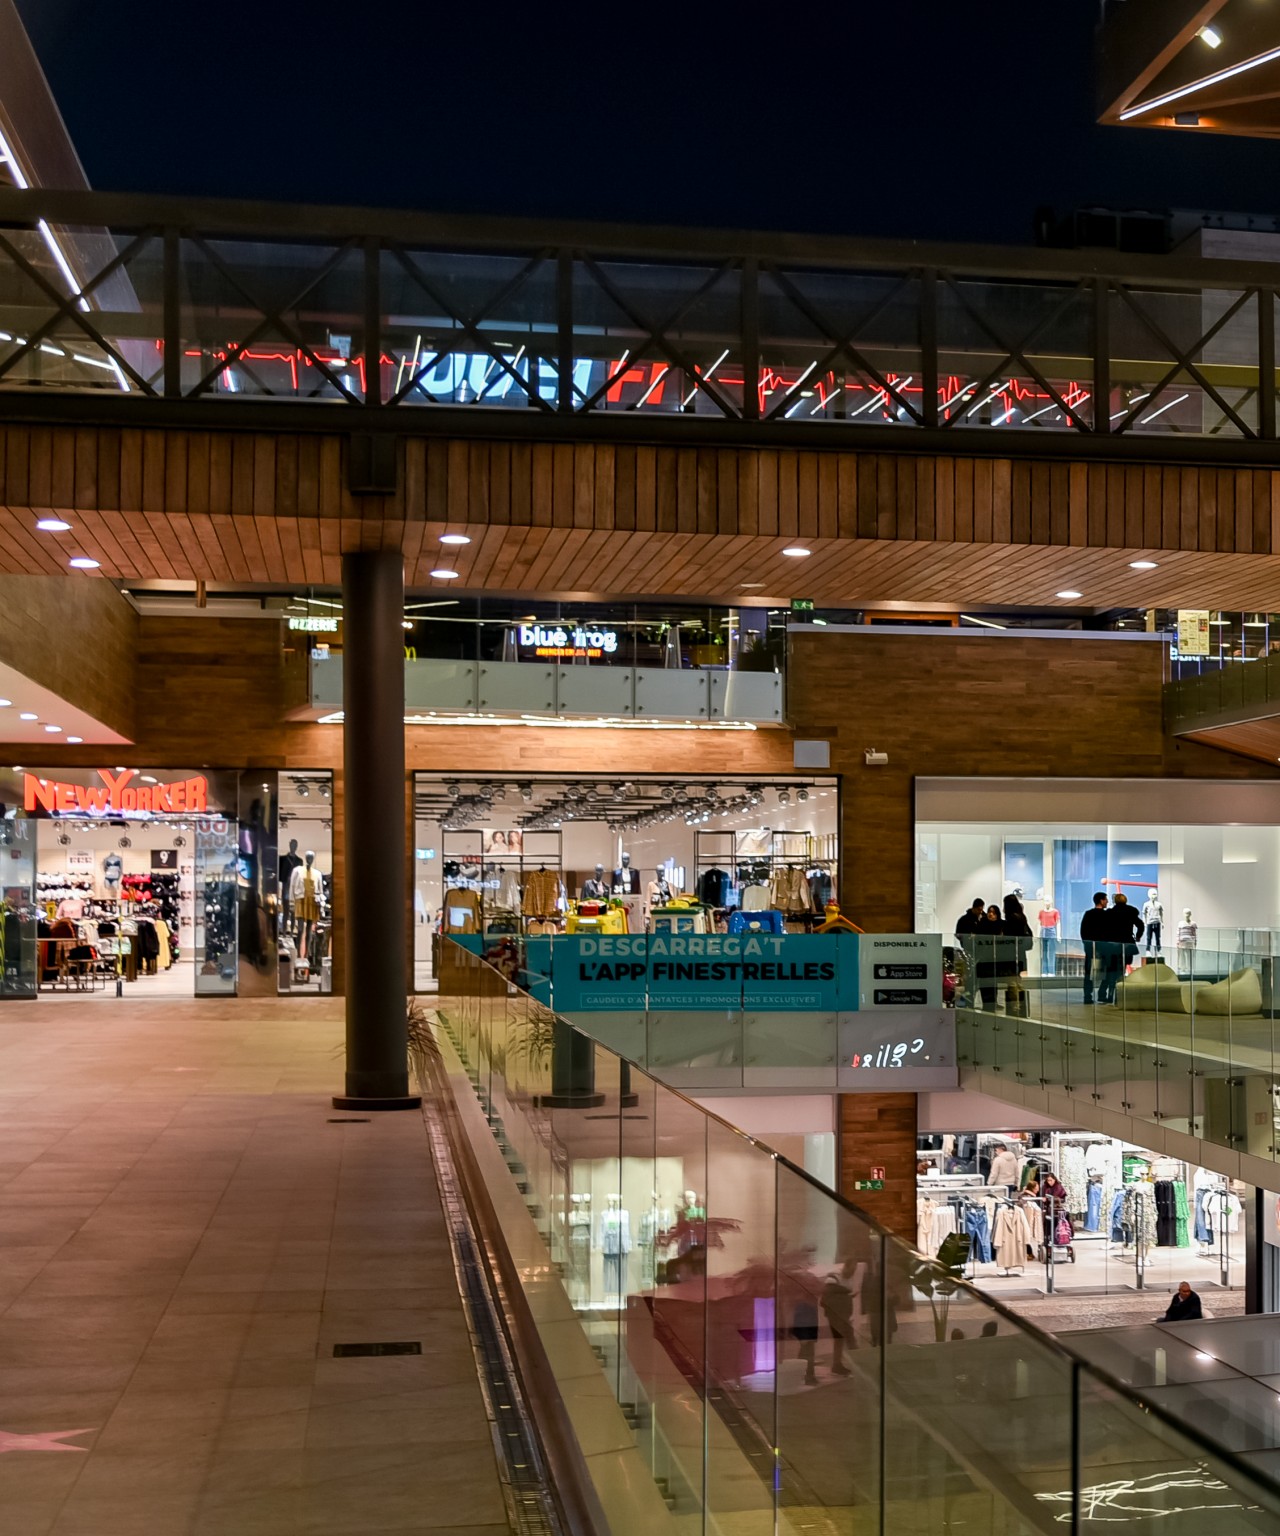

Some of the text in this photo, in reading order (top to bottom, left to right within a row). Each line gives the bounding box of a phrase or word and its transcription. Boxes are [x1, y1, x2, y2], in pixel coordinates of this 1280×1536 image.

[519, 625, 568, 647] blue
[579, 937, 786, 957] DESCARREGA'T
[579, 962, 835, 981] L'APP FINESTRELLES
[763, 996, 816, 1004] EXCLUSIVES
